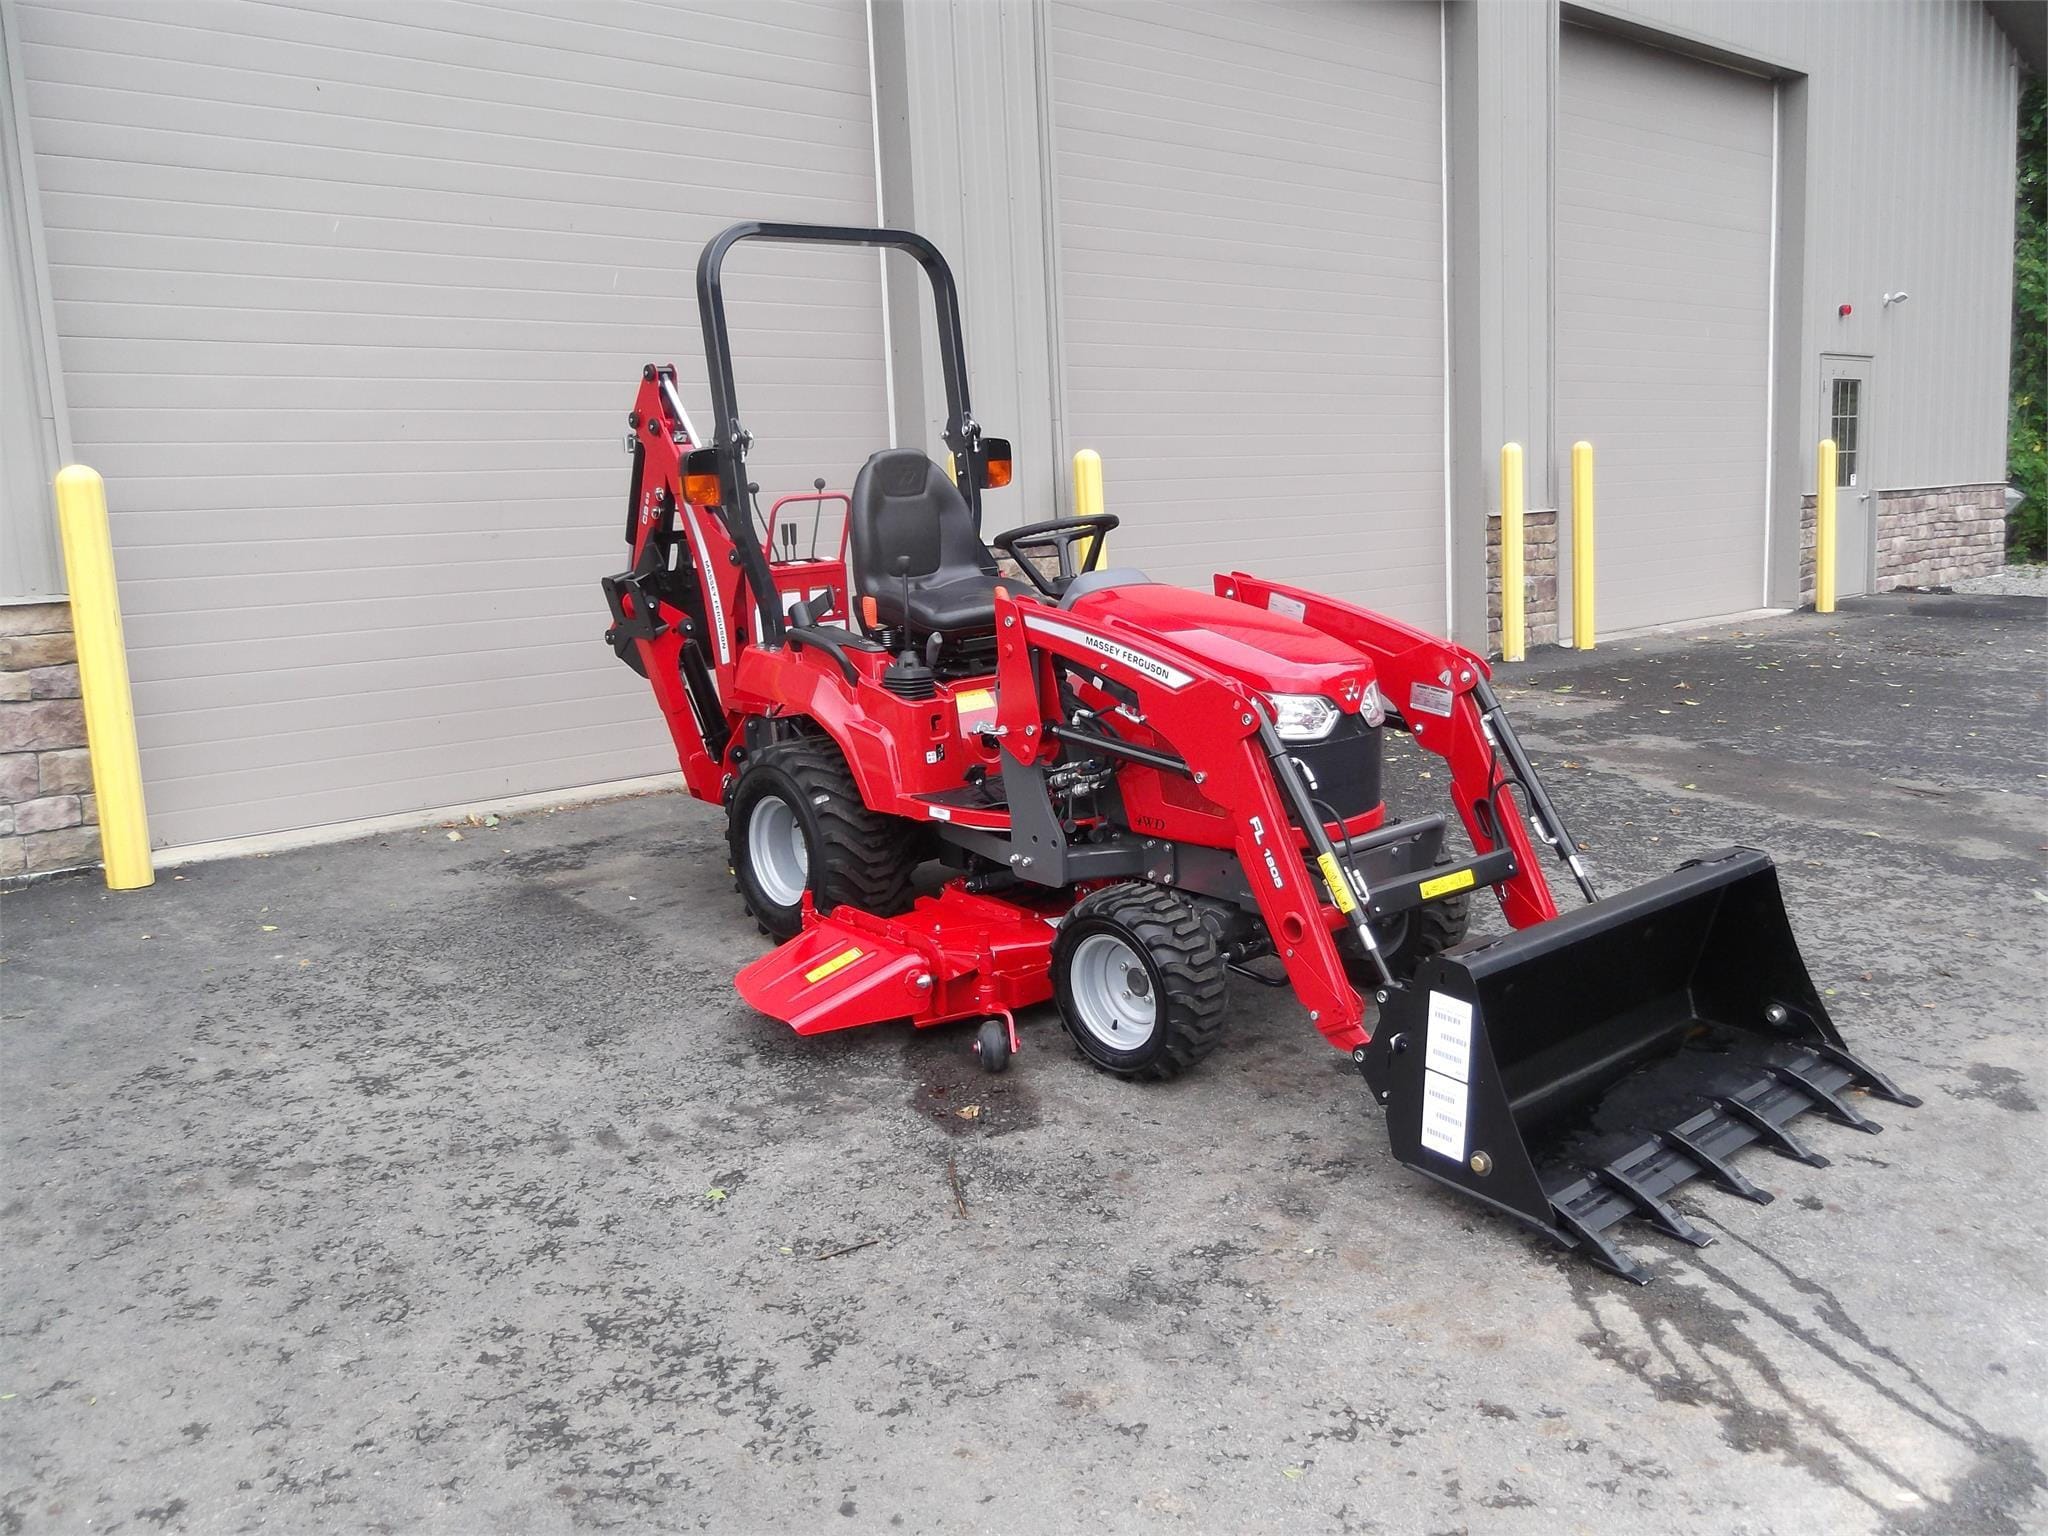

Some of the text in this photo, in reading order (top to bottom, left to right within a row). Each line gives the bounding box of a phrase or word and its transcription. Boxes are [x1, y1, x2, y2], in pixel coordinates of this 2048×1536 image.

[1085, 636, 1170, 680] MASSEY FERGUSON
[1249, 816, 1284, 889] FL 1805
